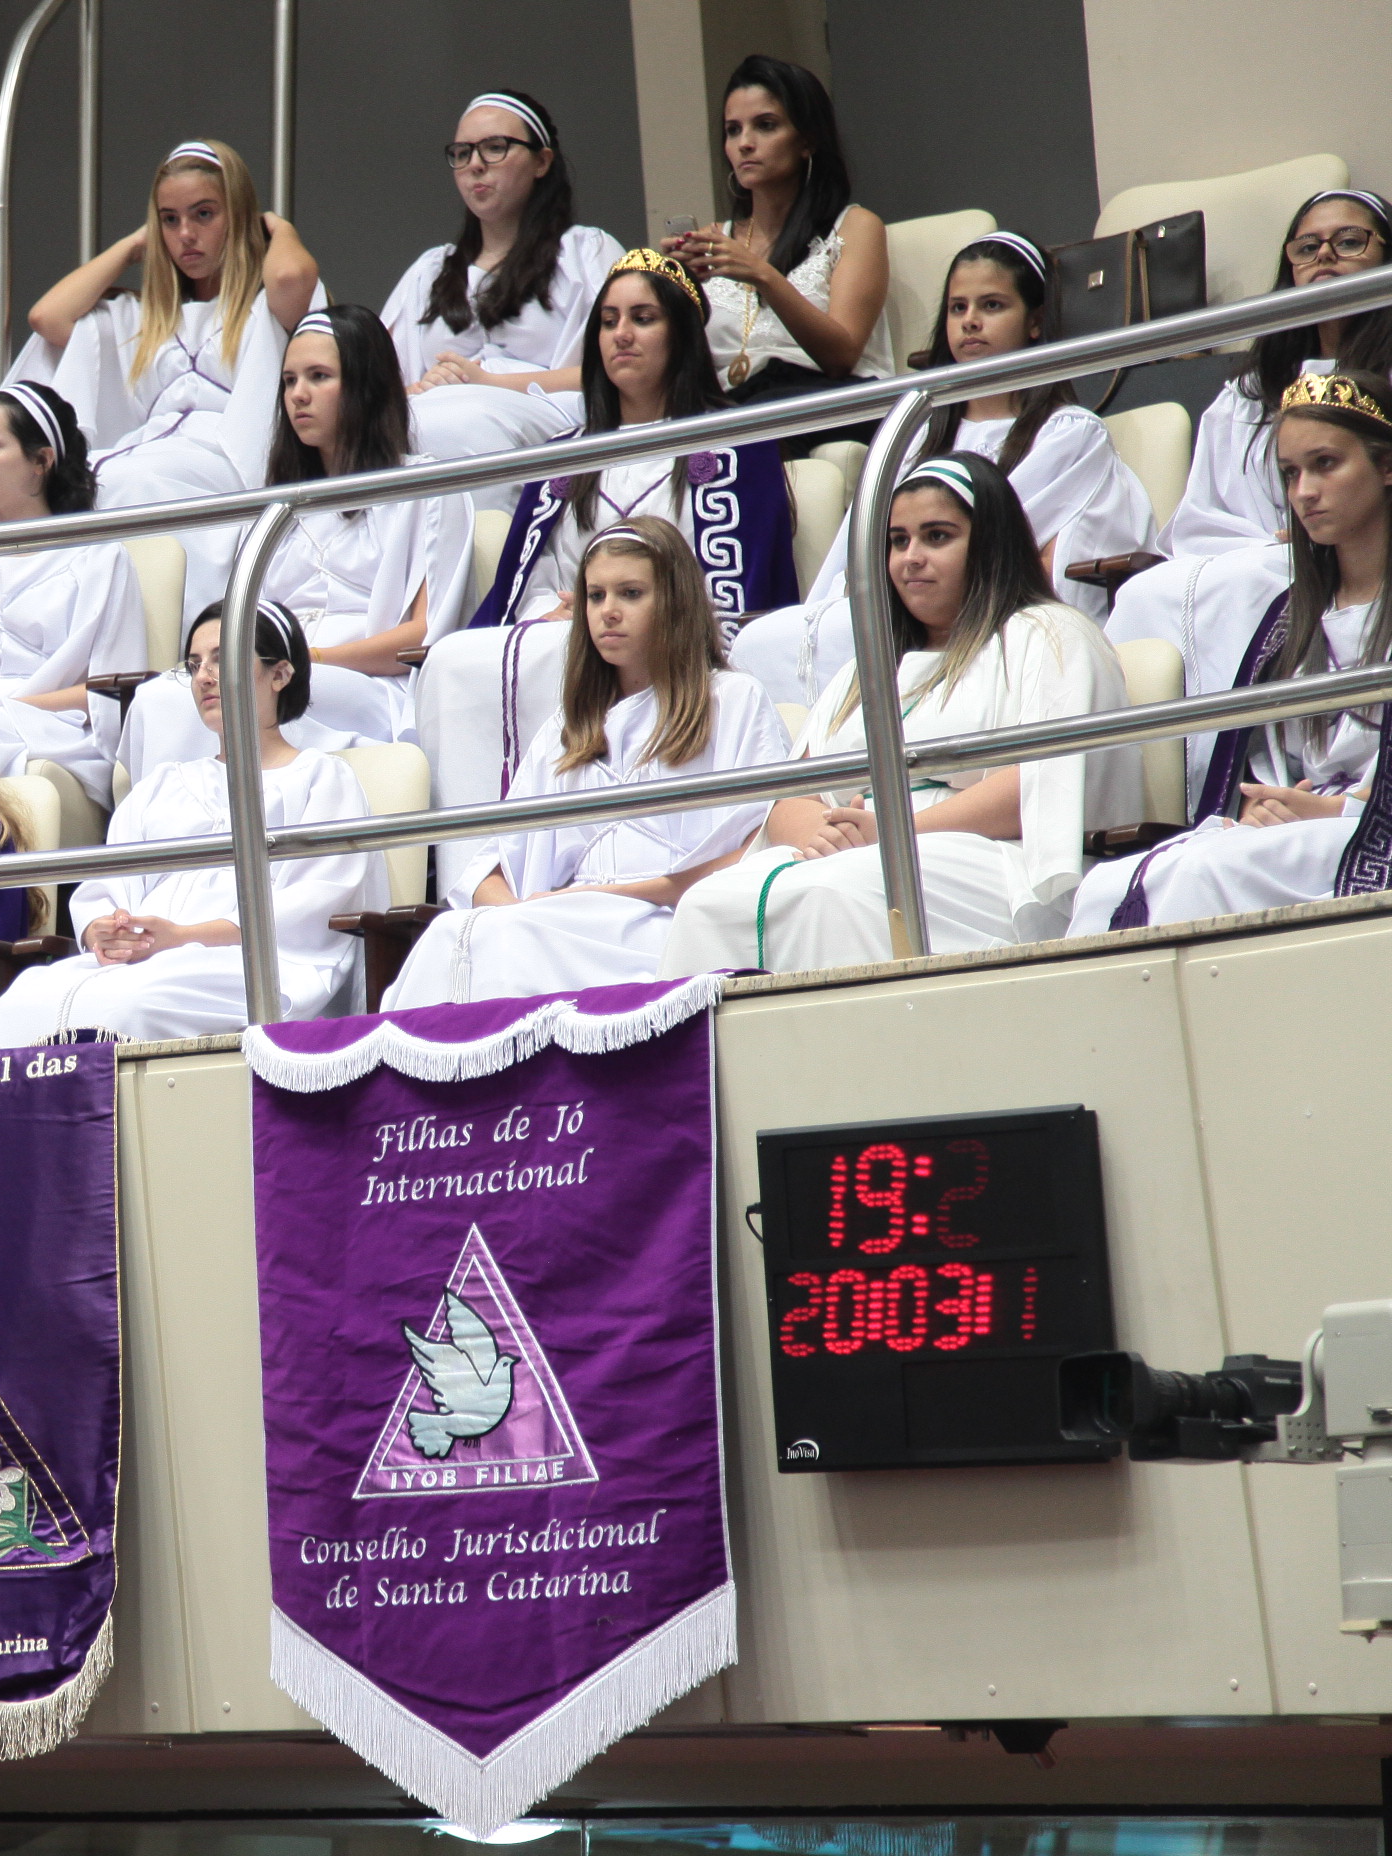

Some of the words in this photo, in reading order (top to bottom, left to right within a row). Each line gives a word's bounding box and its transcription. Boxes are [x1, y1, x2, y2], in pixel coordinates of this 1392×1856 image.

[25, 1052, 78, 1079] das
[372, 1115, 474, 1163] Filhas
[493, 1105, 530, 1143] de
[547, 1101, 584, 1142] Jó
[360, 1147, 595, 1206] Internacional
[390, 1471, 458, 1490] IYOB
[476, 1463, 565, 1486] FILIAE
[300, 1527, 427, 1565] Conselho
[444, 1509, 667, 1563] Jurisdicional
[326, 1575, 359, 1609] de
[374, 1577, 468, 1607] Santa
[486, 1564, 632, 1602] Catarina
